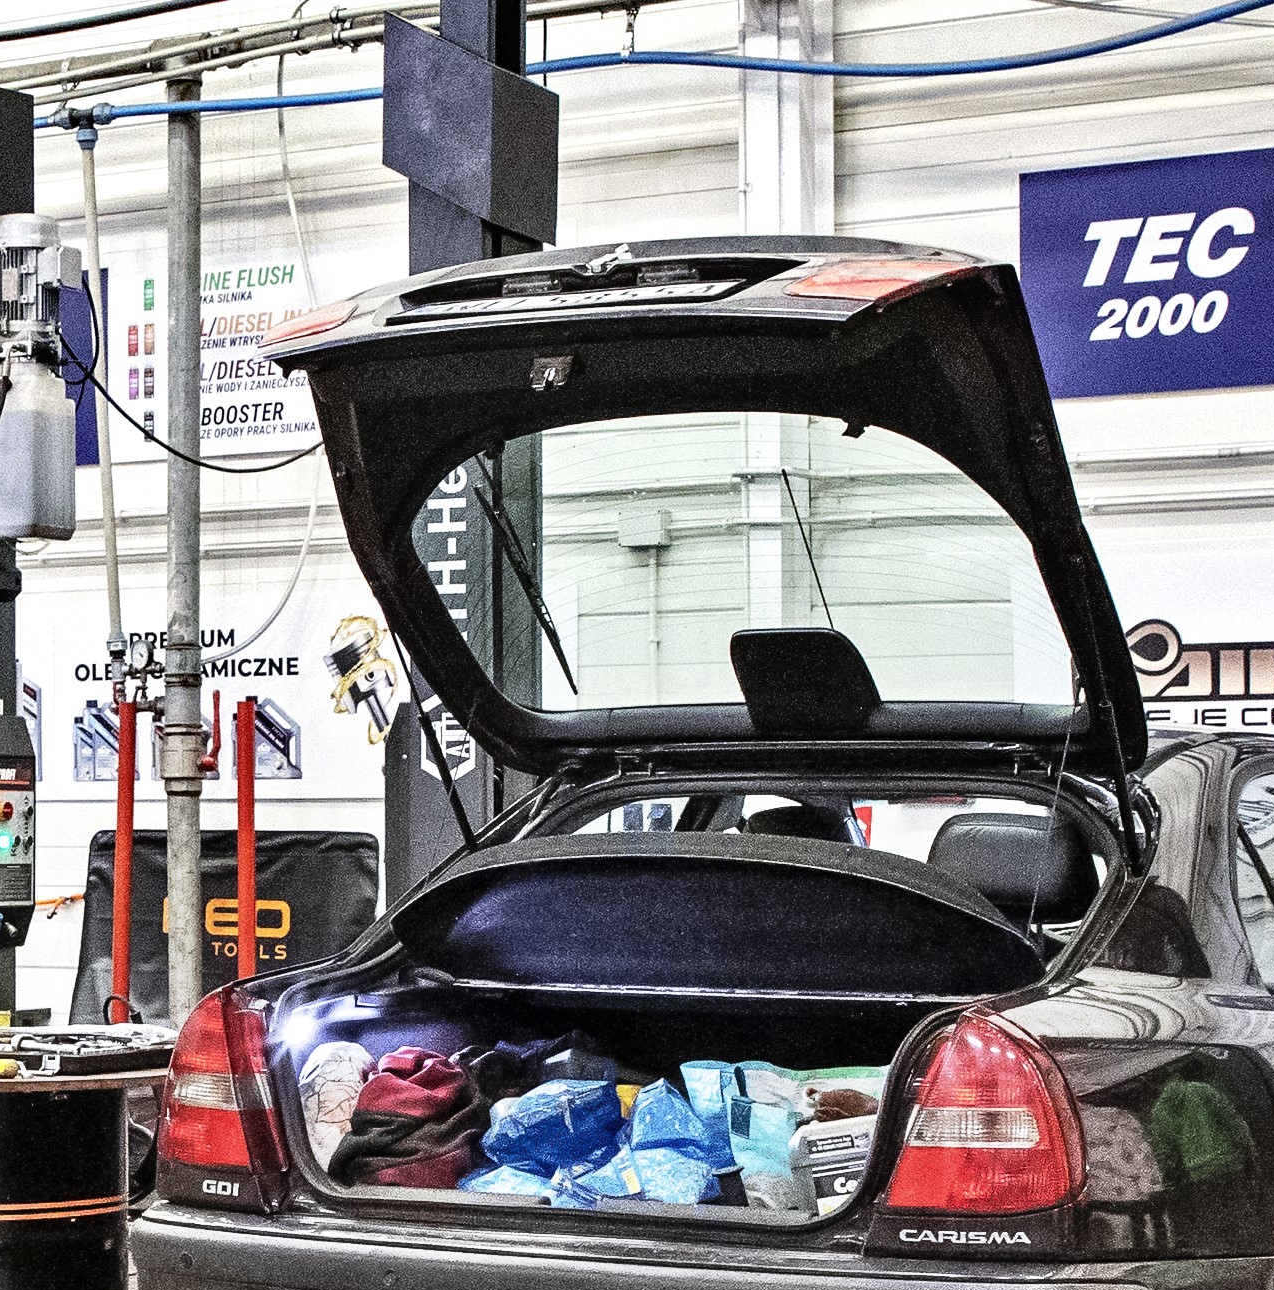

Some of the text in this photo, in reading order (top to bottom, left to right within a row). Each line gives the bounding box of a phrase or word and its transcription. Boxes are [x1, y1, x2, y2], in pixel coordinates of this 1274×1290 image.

[1082, 207, 1255, 287] TEC
[237, 264, 295, 288] FLUSH
[218, 291, 253, 303] SILNIKA
[1089, 289, 1229, 341] 2000
[230, 335, 264, 346] WTRYS
[216, 381, 244, 394] WODY
[201, 402, 284, 426] BOOSTER
[214, 426, 244, 438] OPORY
[247, 424, 278, 436] PRACY
[280, 422, 316, 433] SILNIKA
[212, 942, 287, 960] TOLS
[202, 1179, 240, 1197] GDI
[899, 1229, 1032, 1244] CARISMA
